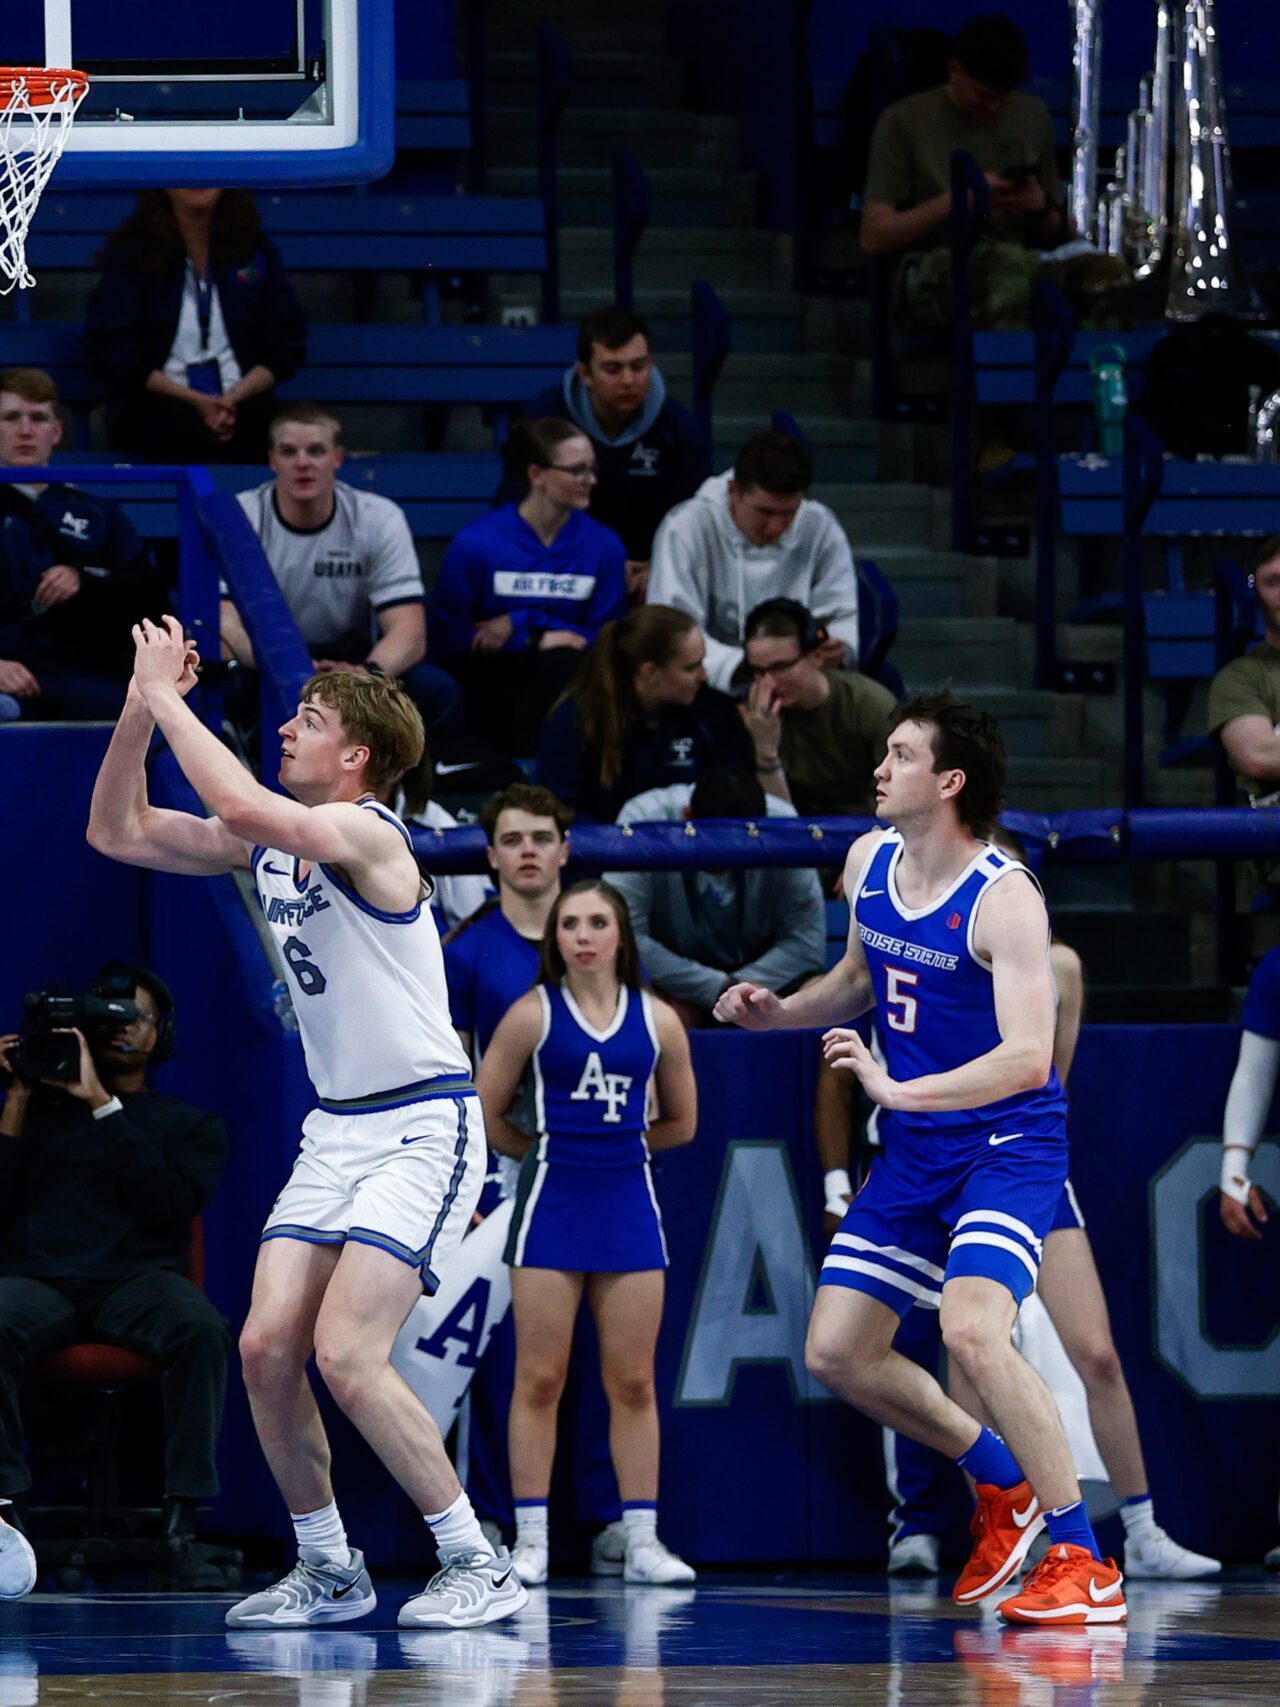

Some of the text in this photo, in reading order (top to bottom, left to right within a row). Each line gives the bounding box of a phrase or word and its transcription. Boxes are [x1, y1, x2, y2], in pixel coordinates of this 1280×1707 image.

[283, 936, 327, 996] 6
[903, 941, 959, 971] STATE
[883, 964, 920, 1034] 5
[570, 1052, 633, 1123] AF
